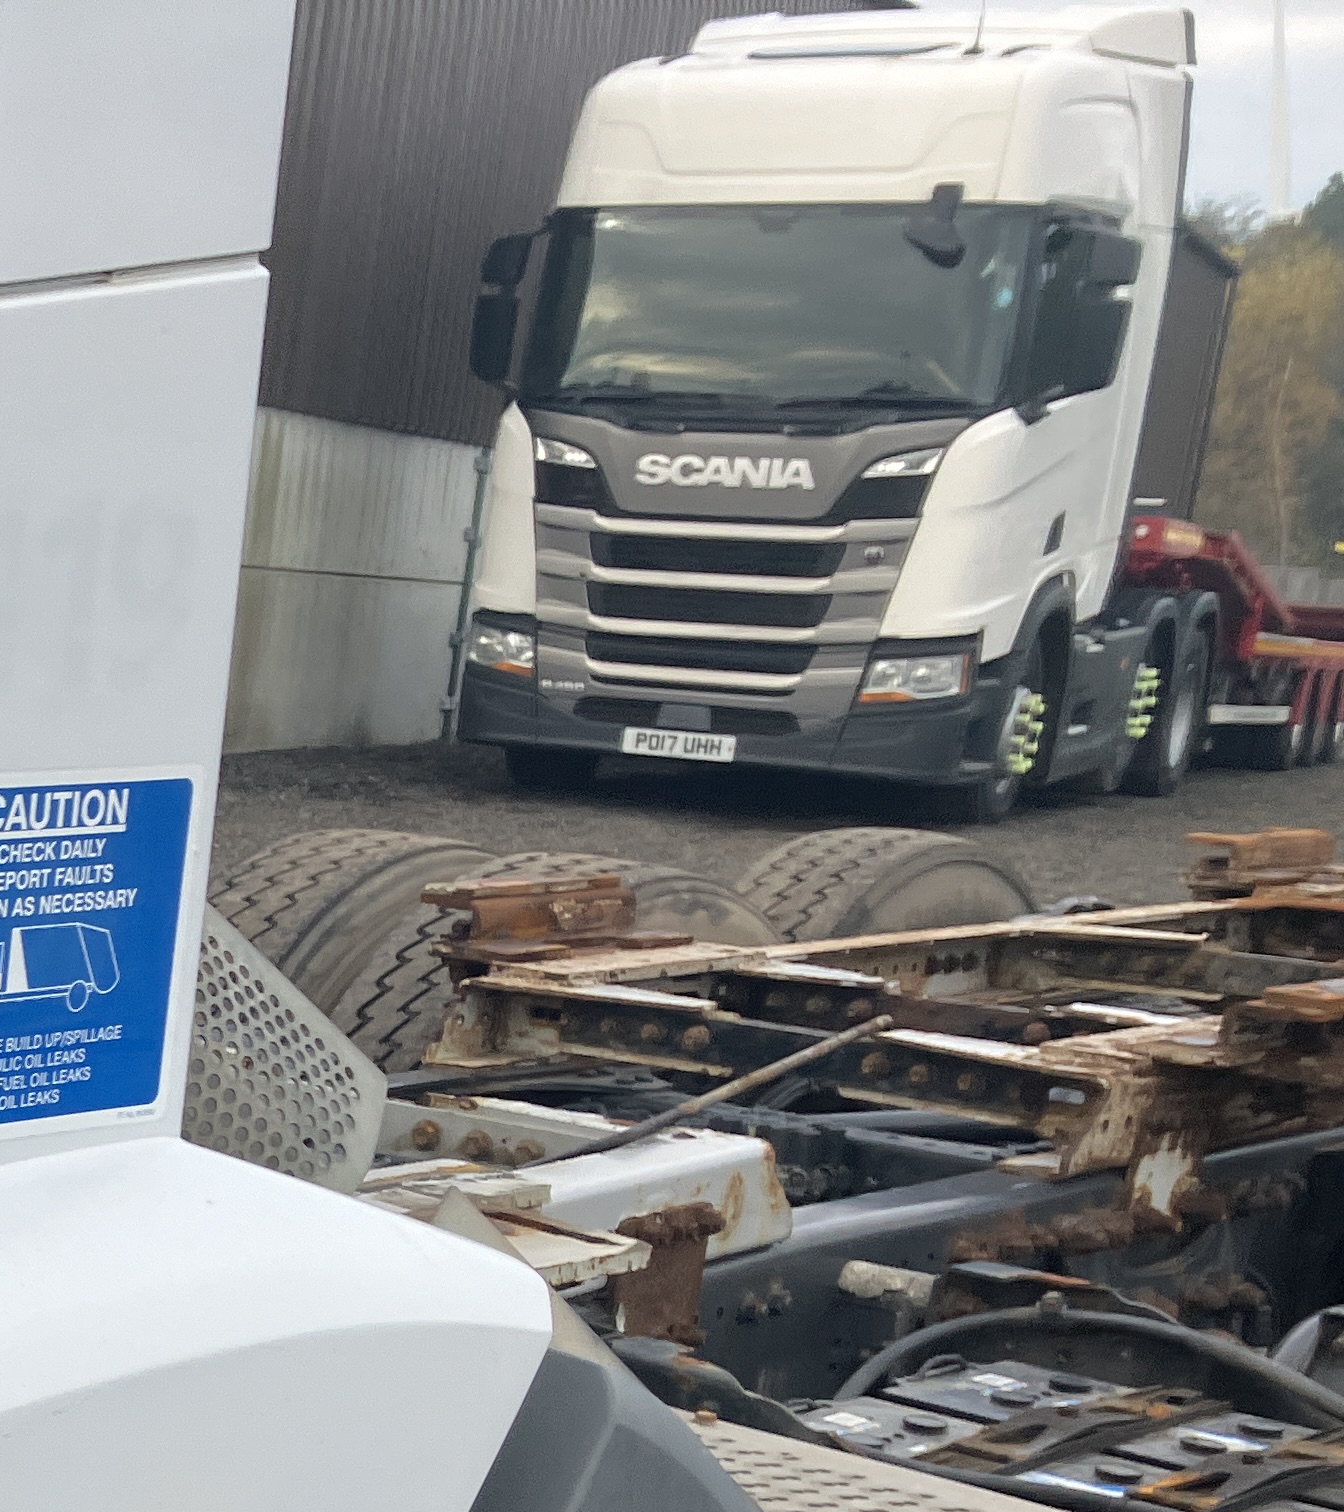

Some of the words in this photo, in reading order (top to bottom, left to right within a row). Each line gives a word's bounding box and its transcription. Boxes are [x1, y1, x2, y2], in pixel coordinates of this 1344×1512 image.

[635, 453, 815, 490] SCANIA
[684, 736, 722, 755] UHH
[60, 838, 107, 859] DAILY
[54, 864, 114, 886] FAULTS
[12, 897, 35, 917] AS
[39, 888, 138, 915] NECESSARY
[6, 1035, 42, 1052] BUILD
[44, 1025, 123, 1048] UP/SPILLAGE
[24, 1054, 46, 1069] OIL
[47, 1049, 86, 1066] LEAKS
[30, 1073, 49, 1087] OIL
[52, 1067, 91, 1084] LEAKS
[20, 1089, 60, 1107] LEAKS
